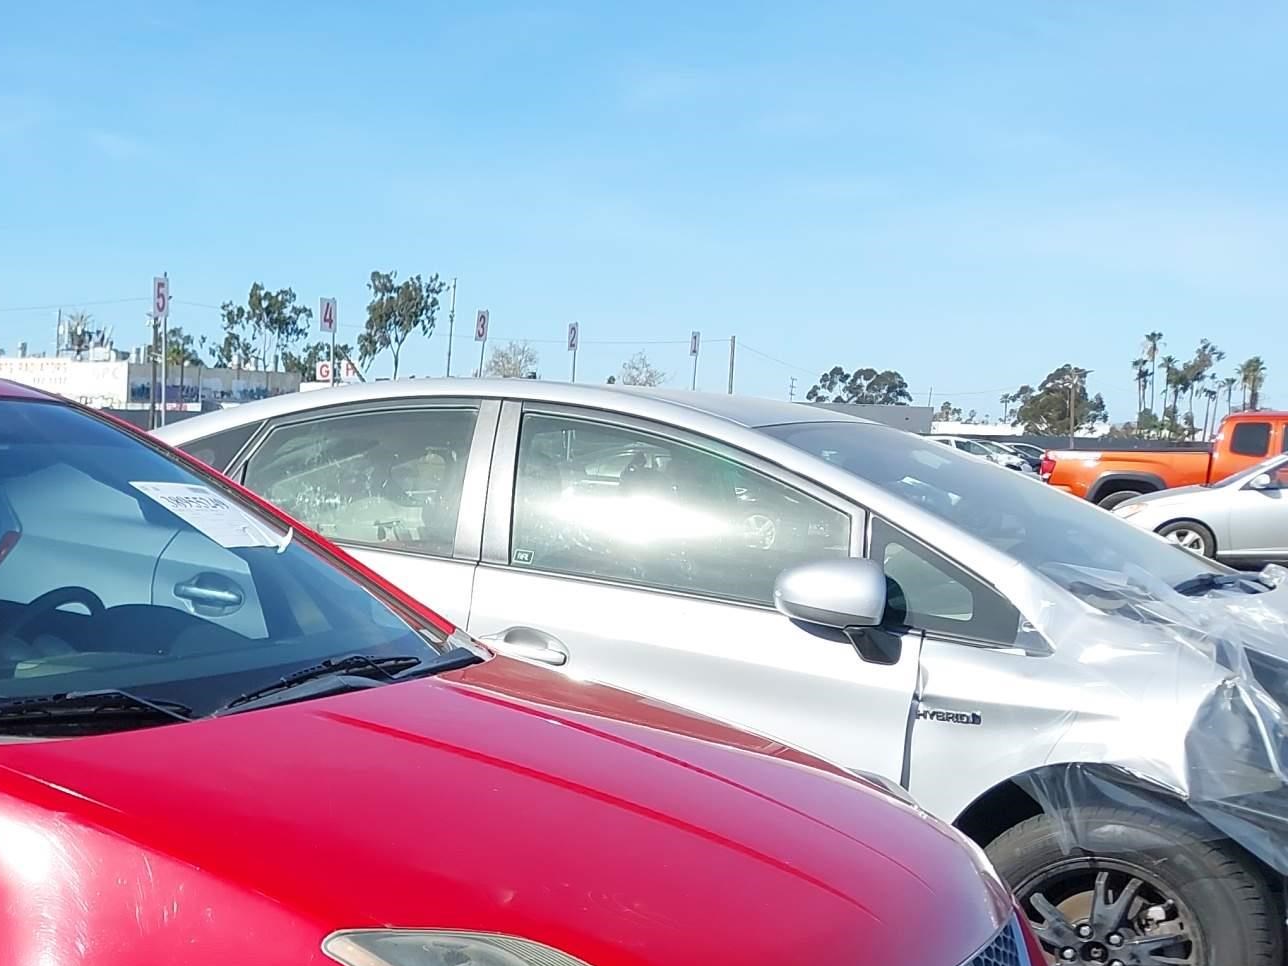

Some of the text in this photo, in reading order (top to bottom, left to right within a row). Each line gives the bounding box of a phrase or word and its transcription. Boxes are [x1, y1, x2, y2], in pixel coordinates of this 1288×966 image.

[157, 282, 165, 313] 5
[323, 302, 333, 329] 4
[477, 314, 486, 338] 3
[569, 327, 576, 347] 2
[692, 335, 697, 353] 1
[320, 363, 330, 378] G
[915, 710, 970, 724] HYBRID
